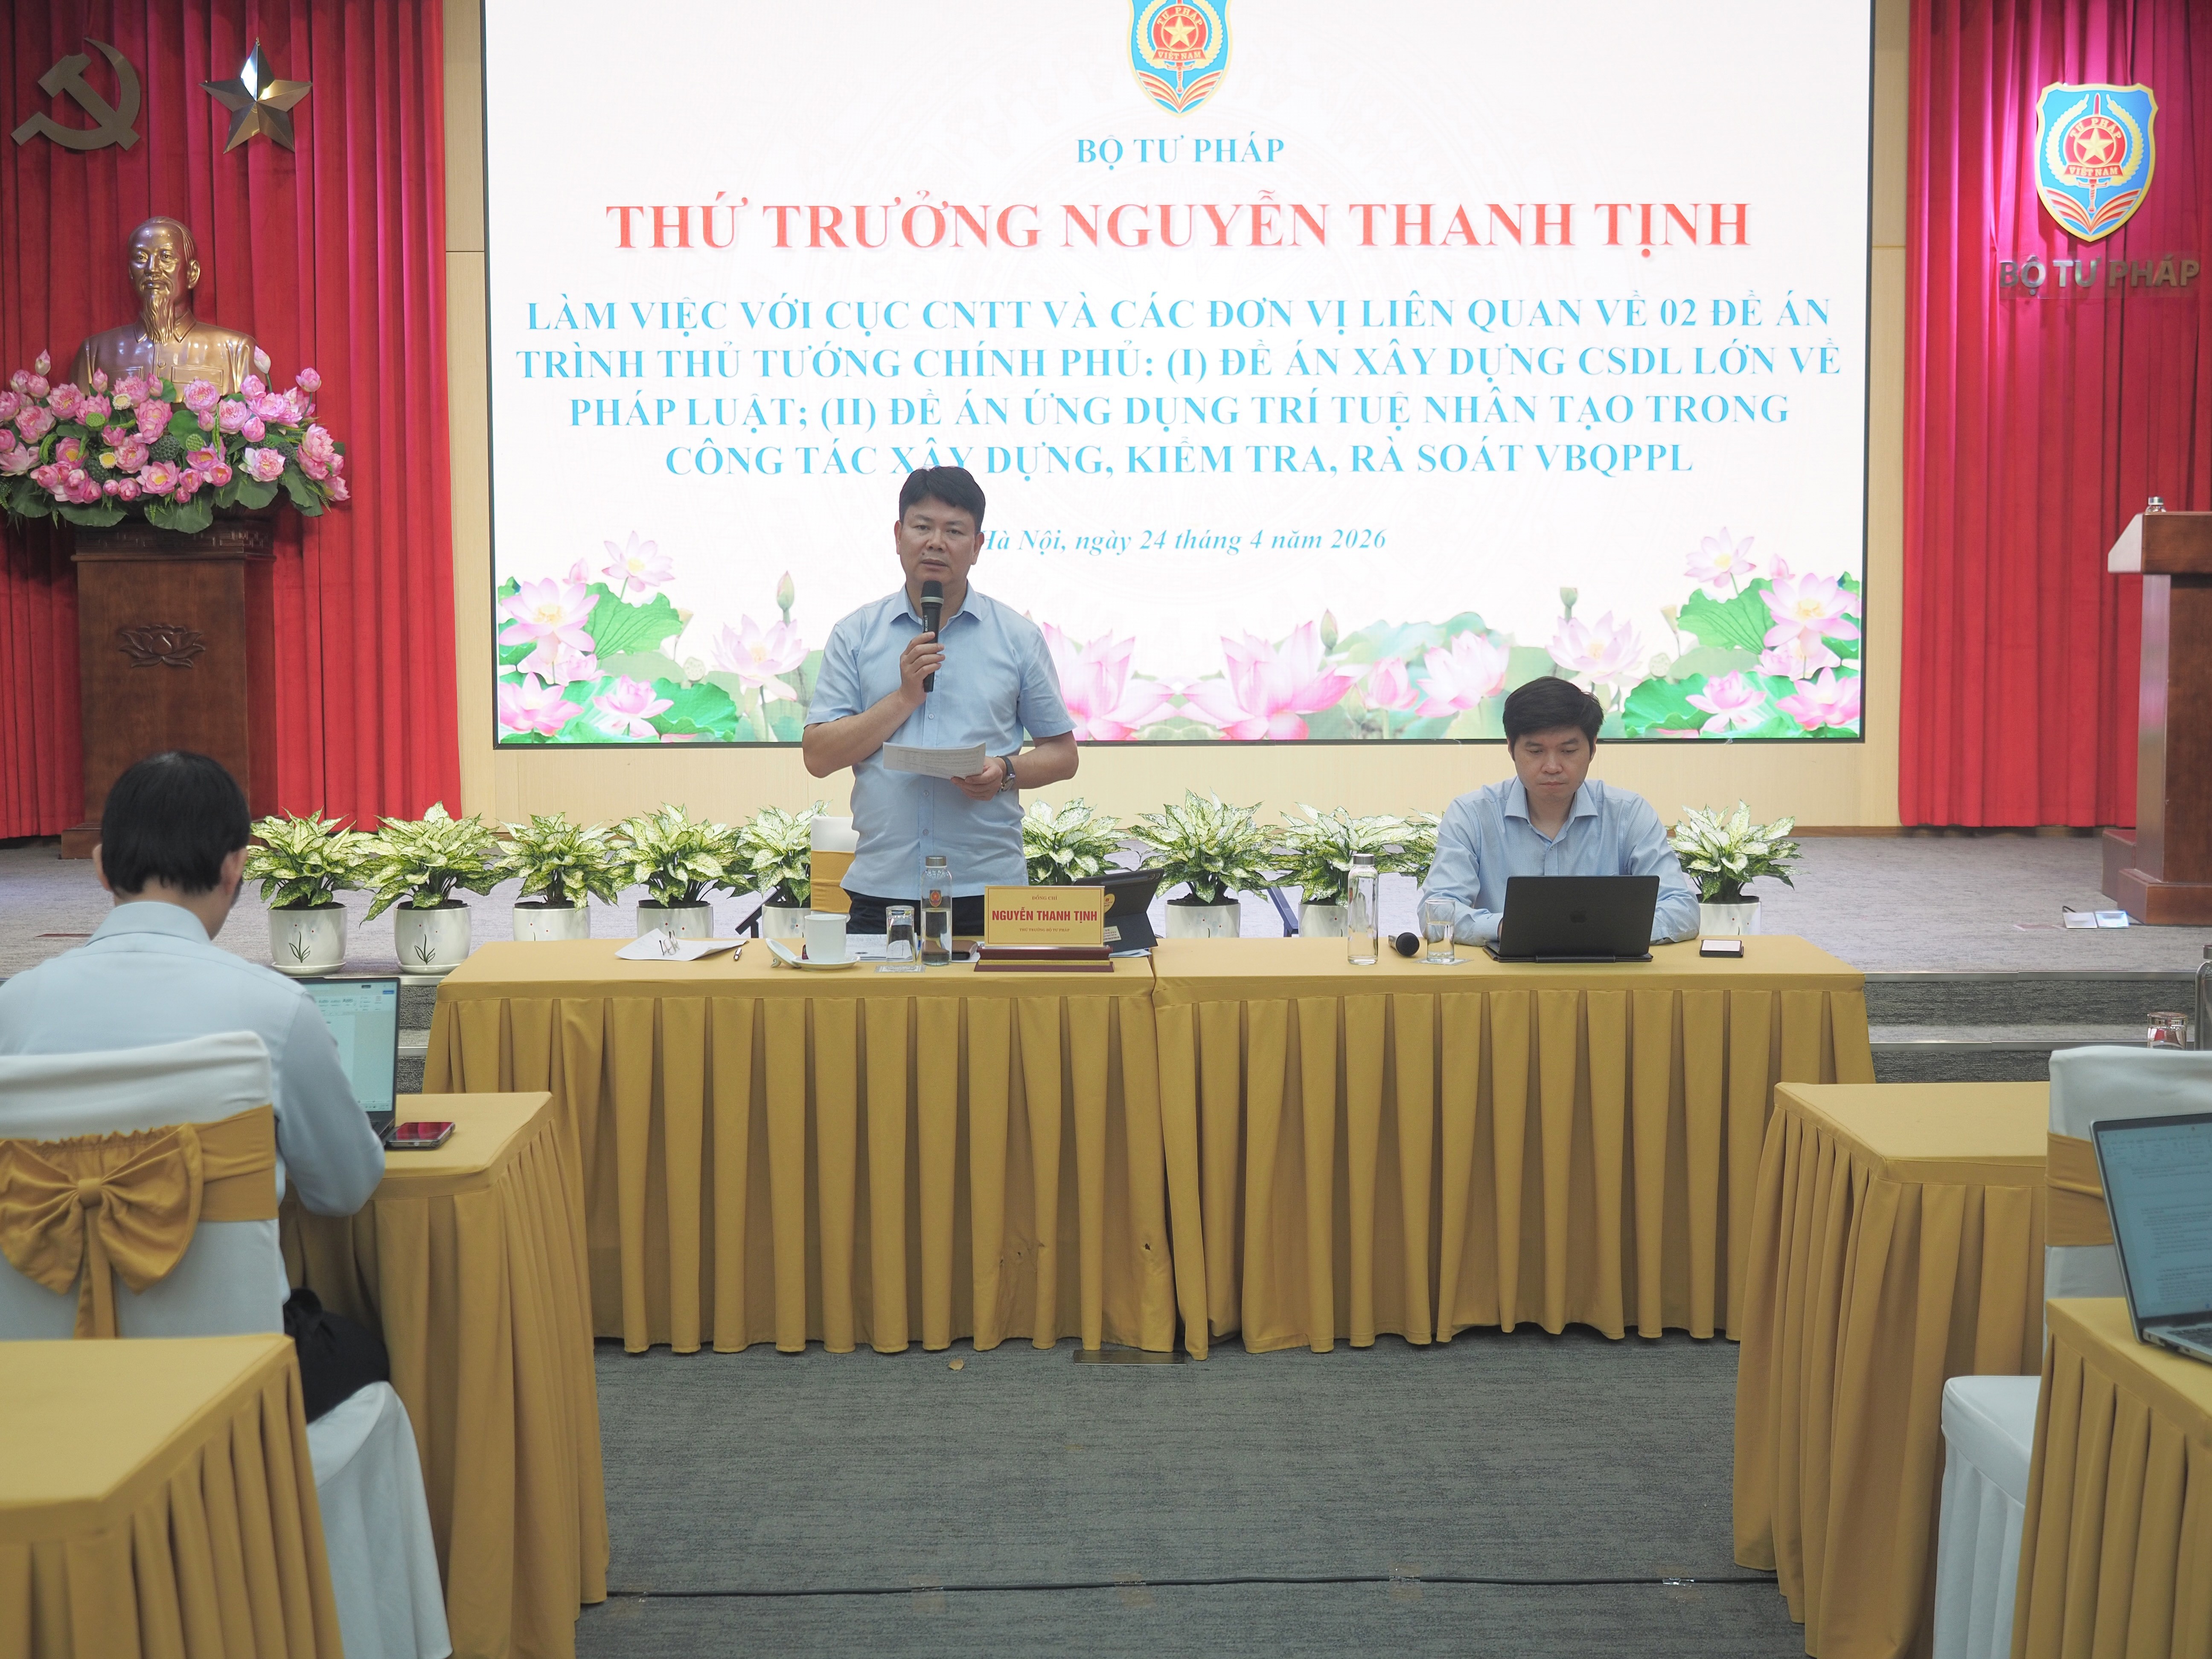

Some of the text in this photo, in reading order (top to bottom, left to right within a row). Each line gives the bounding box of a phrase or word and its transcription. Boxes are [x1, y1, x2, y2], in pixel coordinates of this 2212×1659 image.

[1175, 6, 1203, 25] PHÁP
[1181, 51, 1201, 60] NAM
[1077, 131, 1284, 170] BỘ TƯ PHÁP
[2095, 167, 2118, 176] NAM
[606, 190, 1749, 258] THỨ TRƯỞNG NGUYỄN THANH TỊNH
[1999, 254, 2200, 295] BỘ TƯ PHÁP
[527, 290, 1828, 337] LÀM VIỆC VỚI CỤC CNTT VÀ CÁC ĐƠN VỊ LIÊN QUAN VỀ 02 ĐỀ ÁN
[516, 338, 1840, 383] TRÌNH THỦ TƯỚNG CHÍNH PHỦ: (I) ĐỀ ÁN XÂY DỰNG CSDL LỚN VỀ
[569, 386, 1787, 434] PHÁP LUẬT; (II) ĐỀ ÁN ỨNG DỤNG TRÍ TUỆ NHÂN TẠO TRONG
[667, 436, 1692, 482] CÔNG TÁC XÂY DỰNG, KIỂM TRA, RÀ SOÁT VBQPPL
[1017, 530, 1066, 555] Nội,
[1076, 530, 1131, 556] ngày
[1141, 530, 1167, 549] 24
[1175, 529, 1241, 555] tháng
[1251, 530, 1263, 548] 4
[1272, 530, 1322, 549] năm
[1331, 529, 1385, 548] 2026
[992, 907, 1097, 923] NGUYỄN THANH TỊNH
